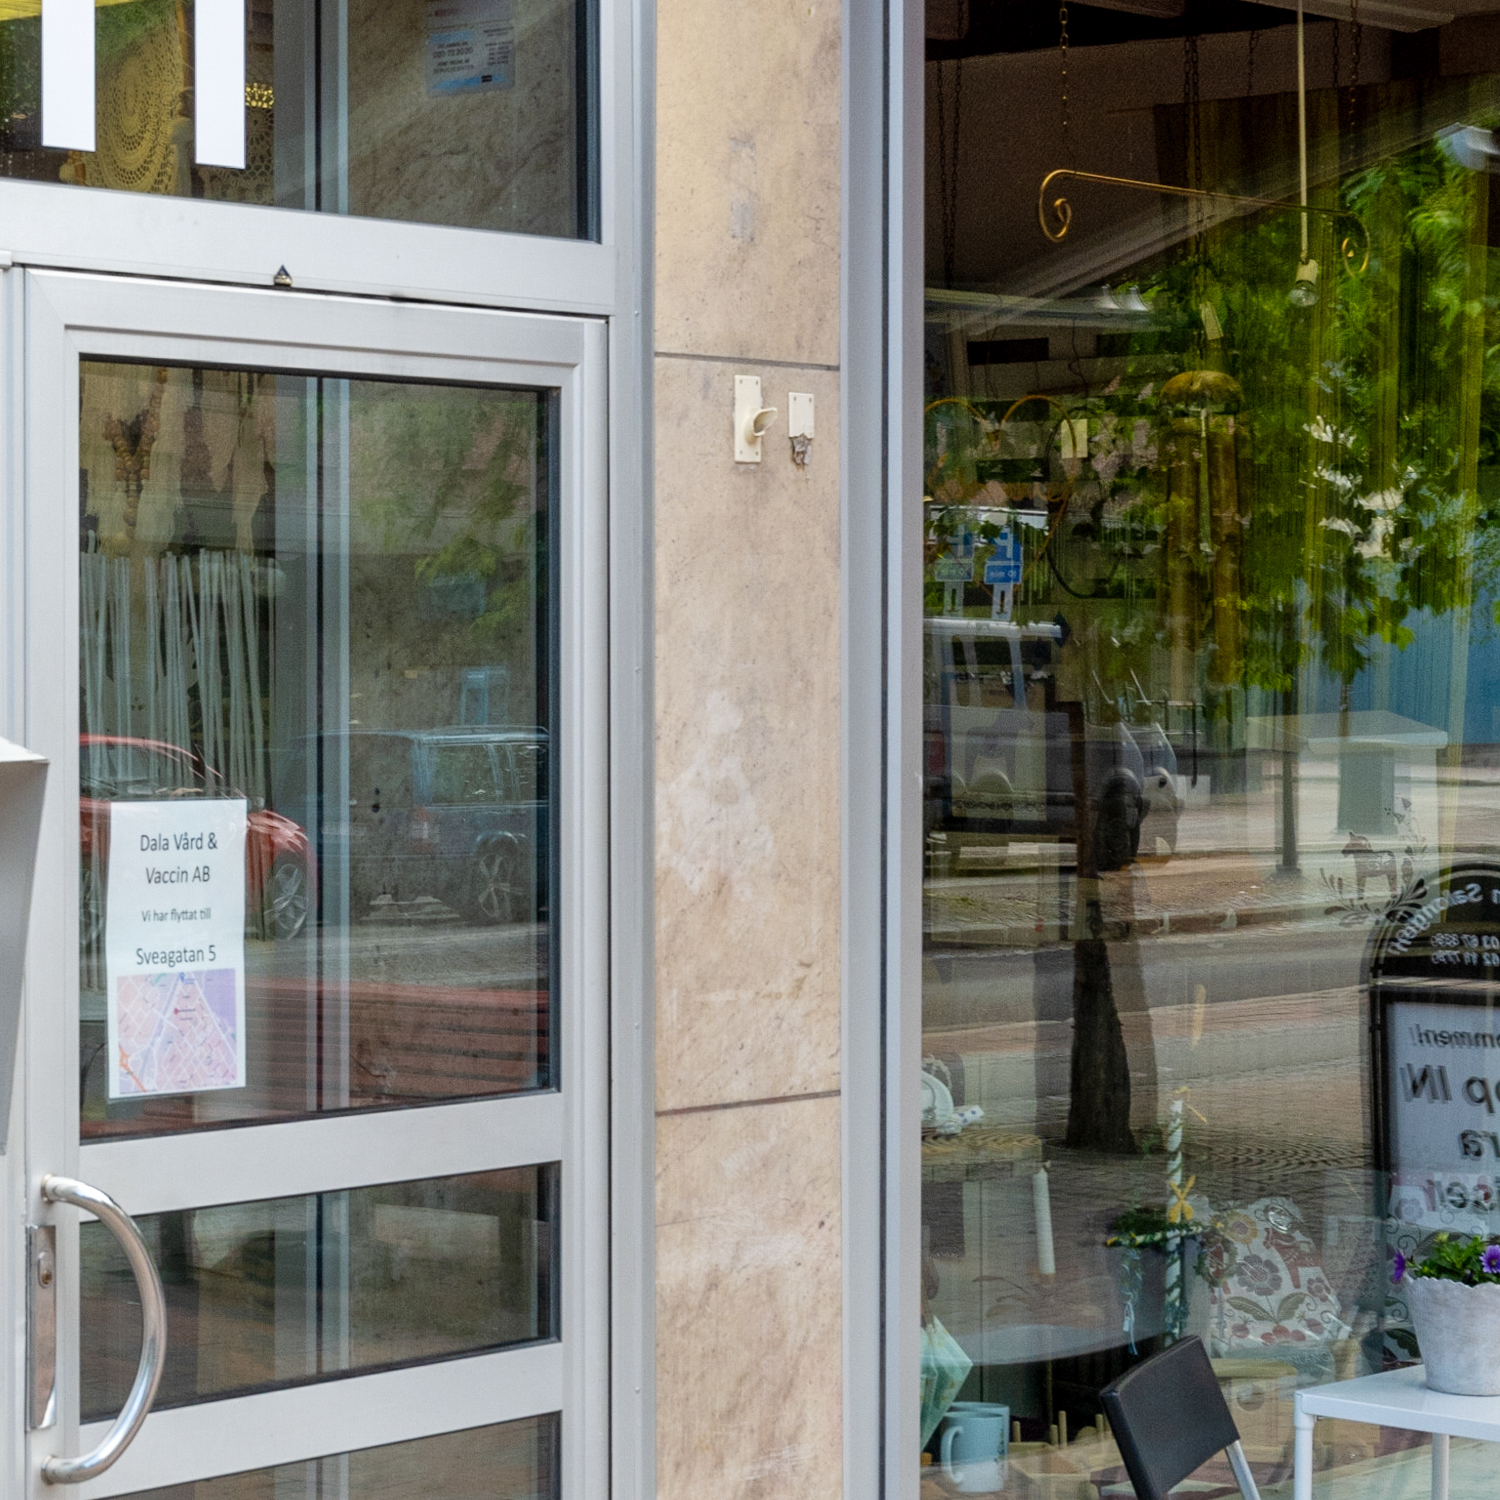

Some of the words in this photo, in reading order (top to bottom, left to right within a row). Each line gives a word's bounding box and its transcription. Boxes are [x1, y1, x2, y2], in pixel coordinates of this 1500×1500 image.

[140, 834, 169, 851] Dala
[174, 832, 203, 850] Vård
[207, 832, 218, 849] &
[146, 866, 188, 884] Vaccin
[192, 866, 210, 882] AB
[141, 910, 150, 922] Vi
[153, 910, 168, 922] har
[170, 908, 197, 923] flyttat
[200, 907, 211, 920] till
[136, 947, 204, 968] Sveagatan
[208, 945, 216, 961] 5
